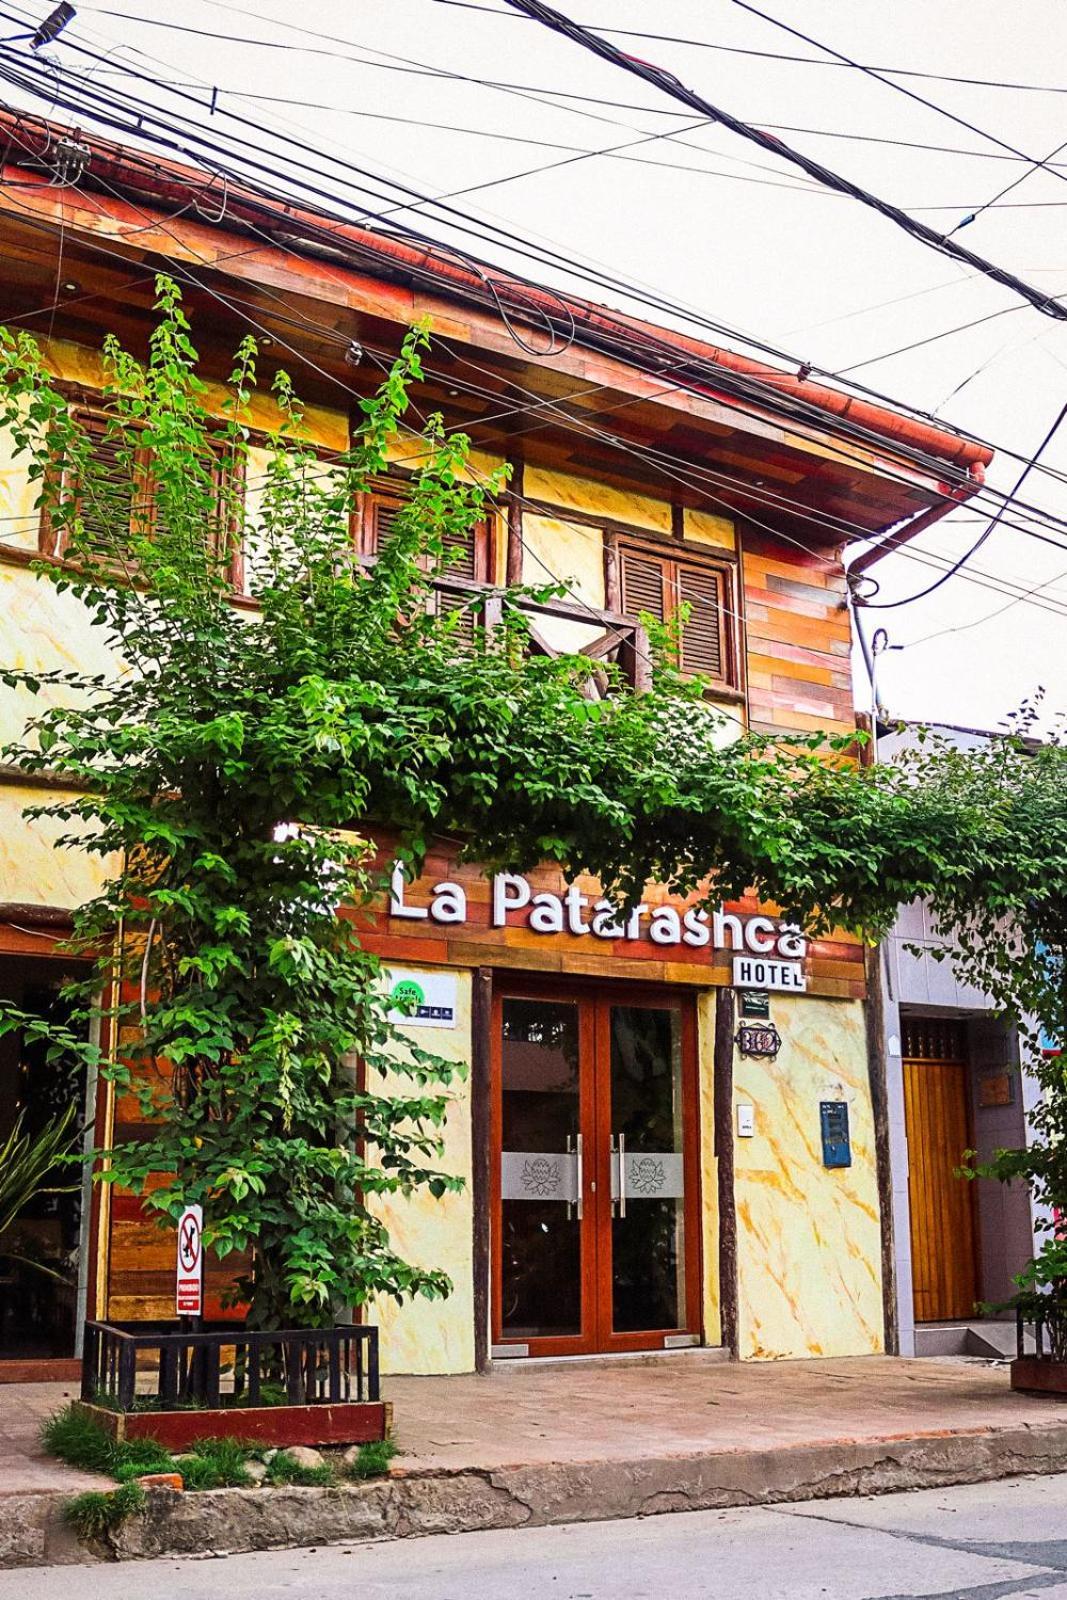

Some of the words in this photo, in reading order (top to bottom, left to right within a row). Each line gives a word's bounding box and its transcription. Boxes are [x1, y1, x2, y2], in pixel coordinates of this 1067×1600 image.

[391, 859, 467, 922] La
[493, 871, 806, 957] Patarashca
[741, 962, 803, 987] HOTEL
[399, 987, 417, 996] Safe
